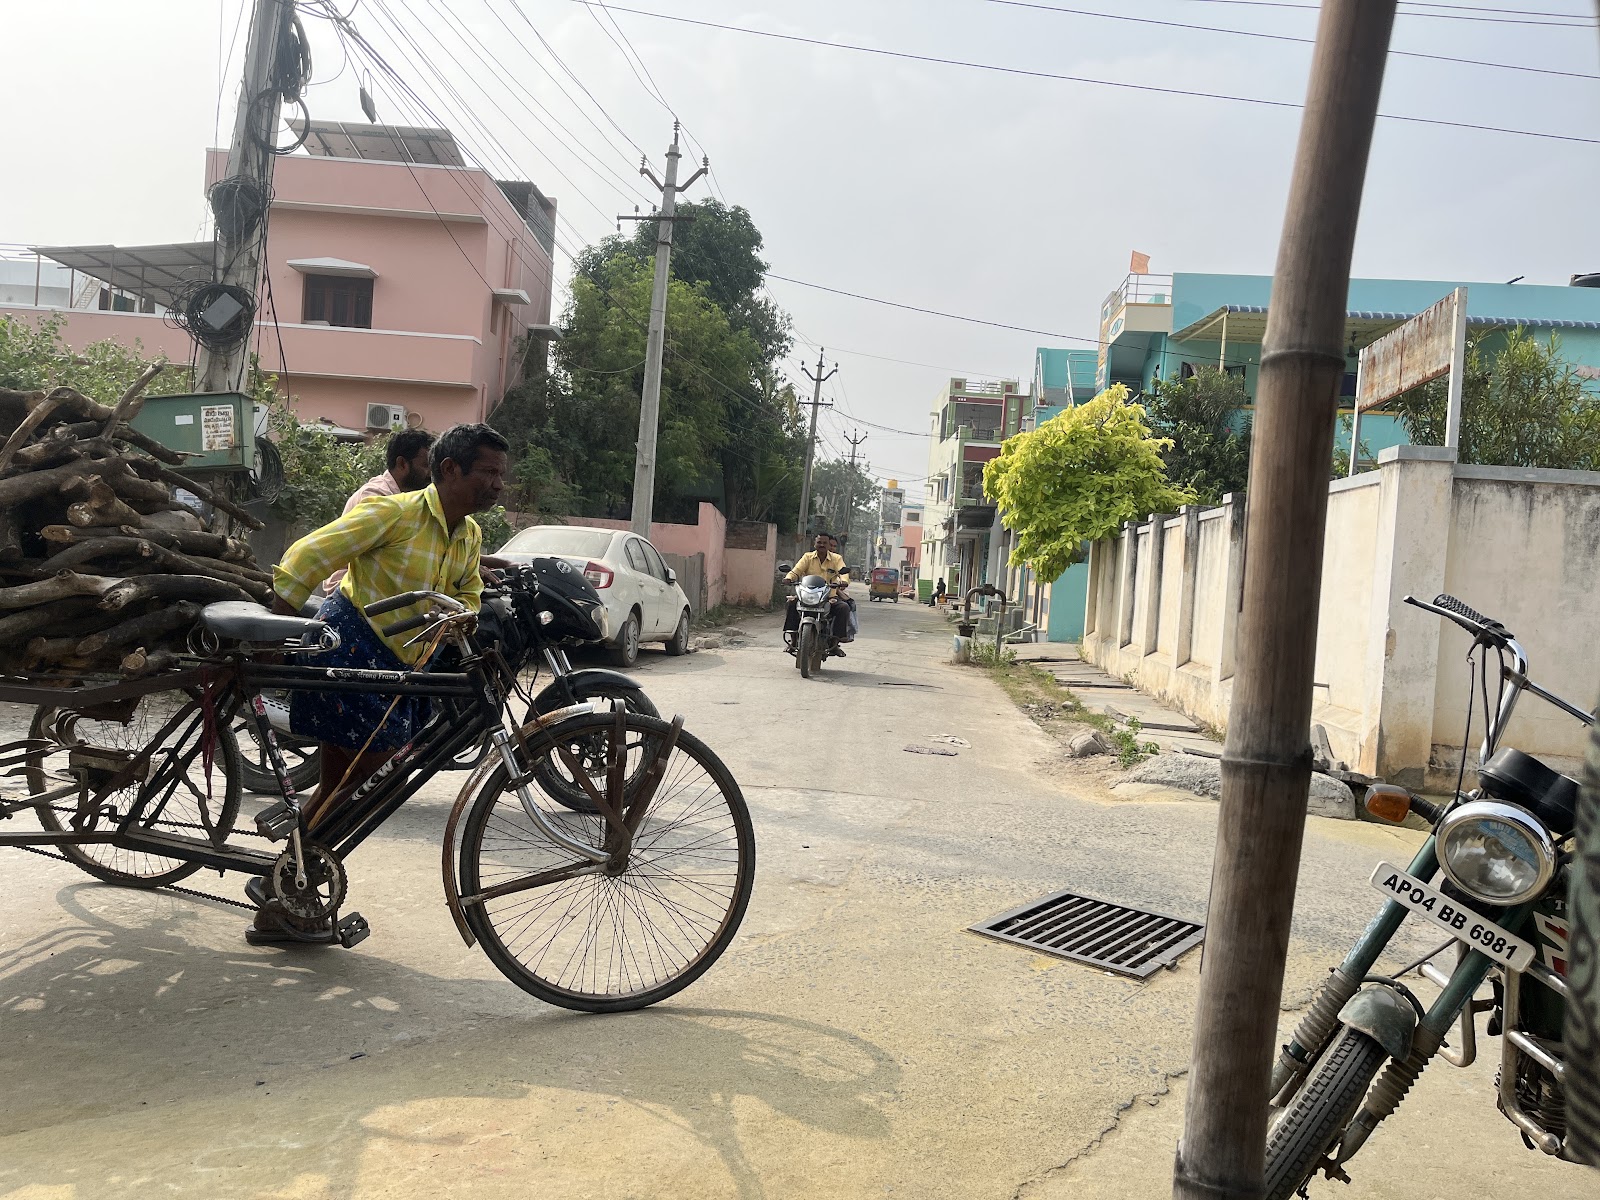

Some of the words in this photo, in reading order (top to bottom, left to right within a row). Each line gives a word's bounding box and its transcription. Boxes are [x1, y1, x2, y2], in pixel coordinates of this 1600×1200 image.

[378, 673, 399, 681] Frame
[1437, 904, 1468, 930] BB
[1469, 923, 1518, 961] 6981
